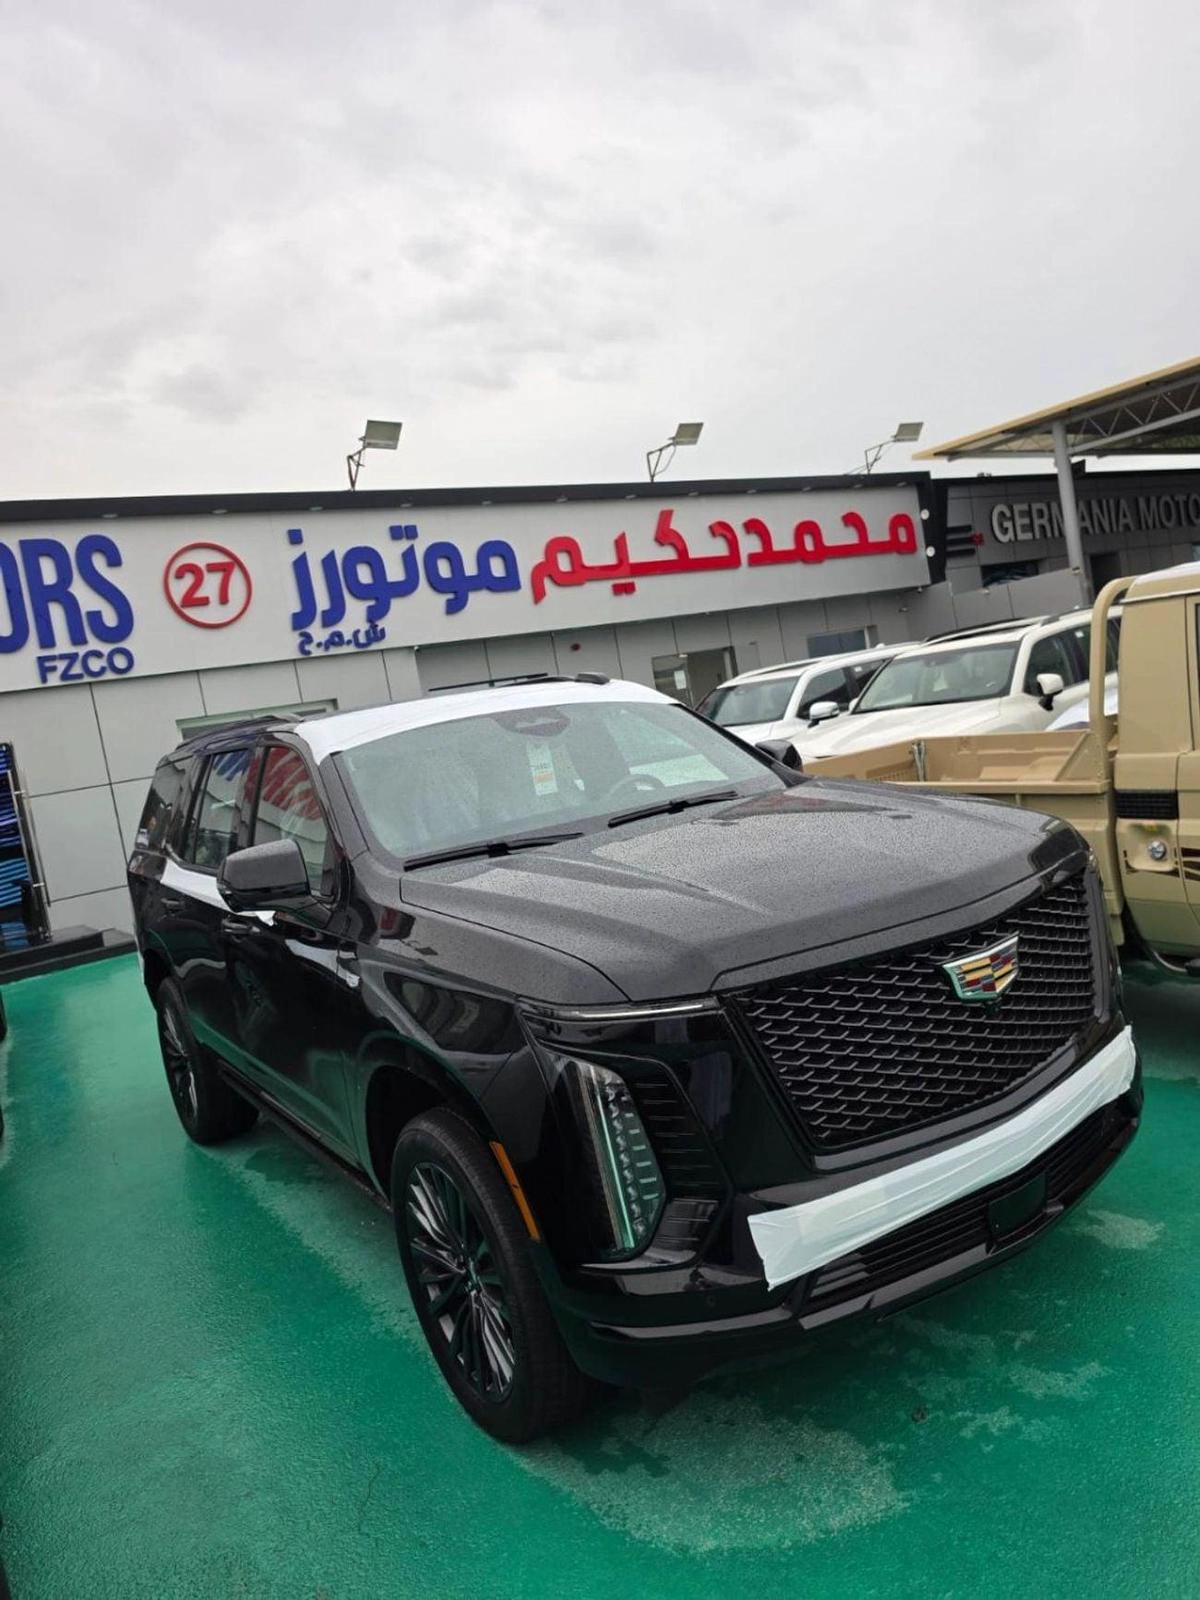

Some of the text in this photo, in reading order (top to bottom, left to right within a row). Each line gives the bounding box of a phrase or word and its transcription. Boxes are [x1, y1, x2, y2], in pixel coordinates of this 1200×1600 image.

[174, 561, 236, 610] 27
[288, 508, 918, 632] محمد حكيم موتورز
[36, 646, 135, 685] FZCO
